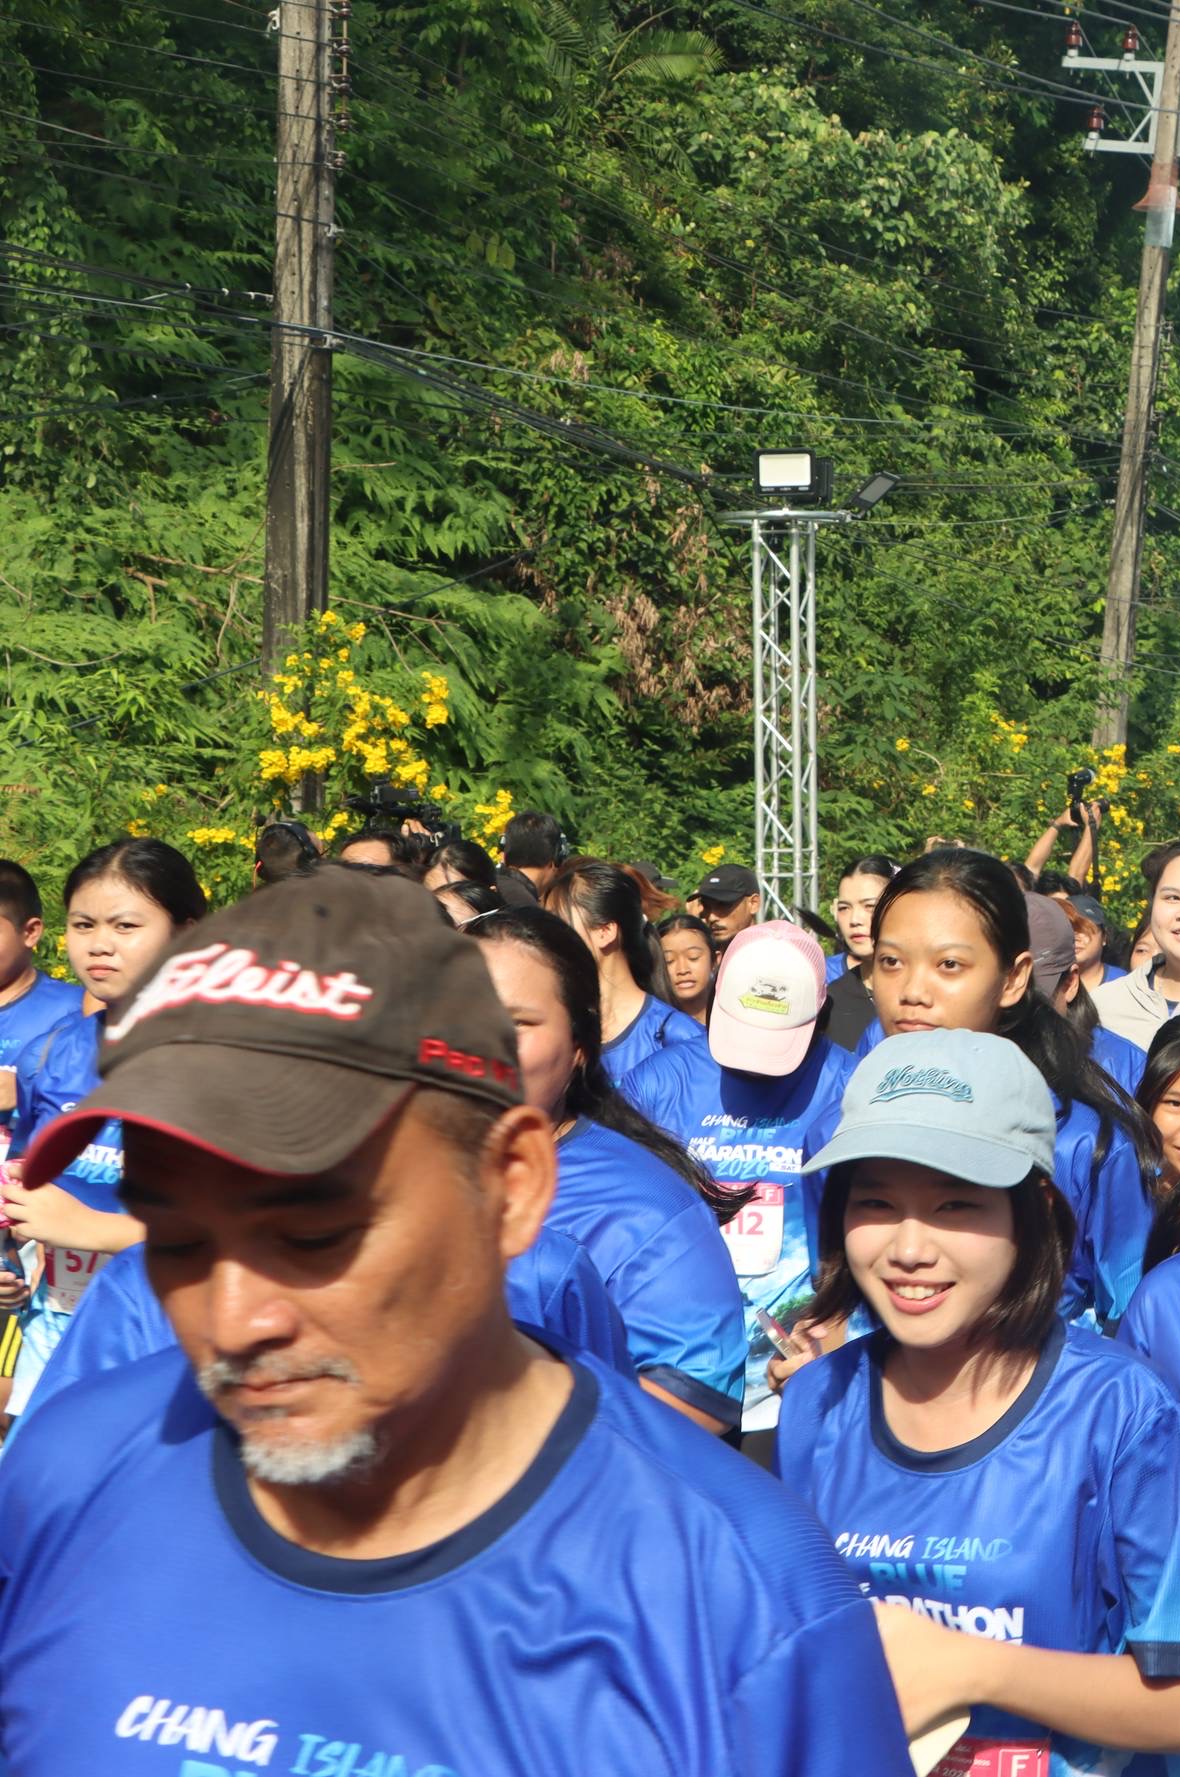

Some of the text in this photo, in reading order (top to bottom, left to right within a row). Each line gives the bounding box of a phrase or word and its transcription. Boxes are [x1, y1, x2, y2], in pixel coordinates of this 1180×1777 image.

[701, 1114, 749, 1128] CHANG
[690, 1137, 716, 1146] HALF
[688, 1144, 803, 1166] MARATHON
[716, 1159, 770, 1180] 2026
[765, 1188, 775, 1202] F
[834, 1532, 1013, 1562] CHANG ISLAND
[869, 1562, 967, 1593] BLUE
[115, 1696, 279, 1766] CHANG
[1011, 1754, 1030, 1777] F
